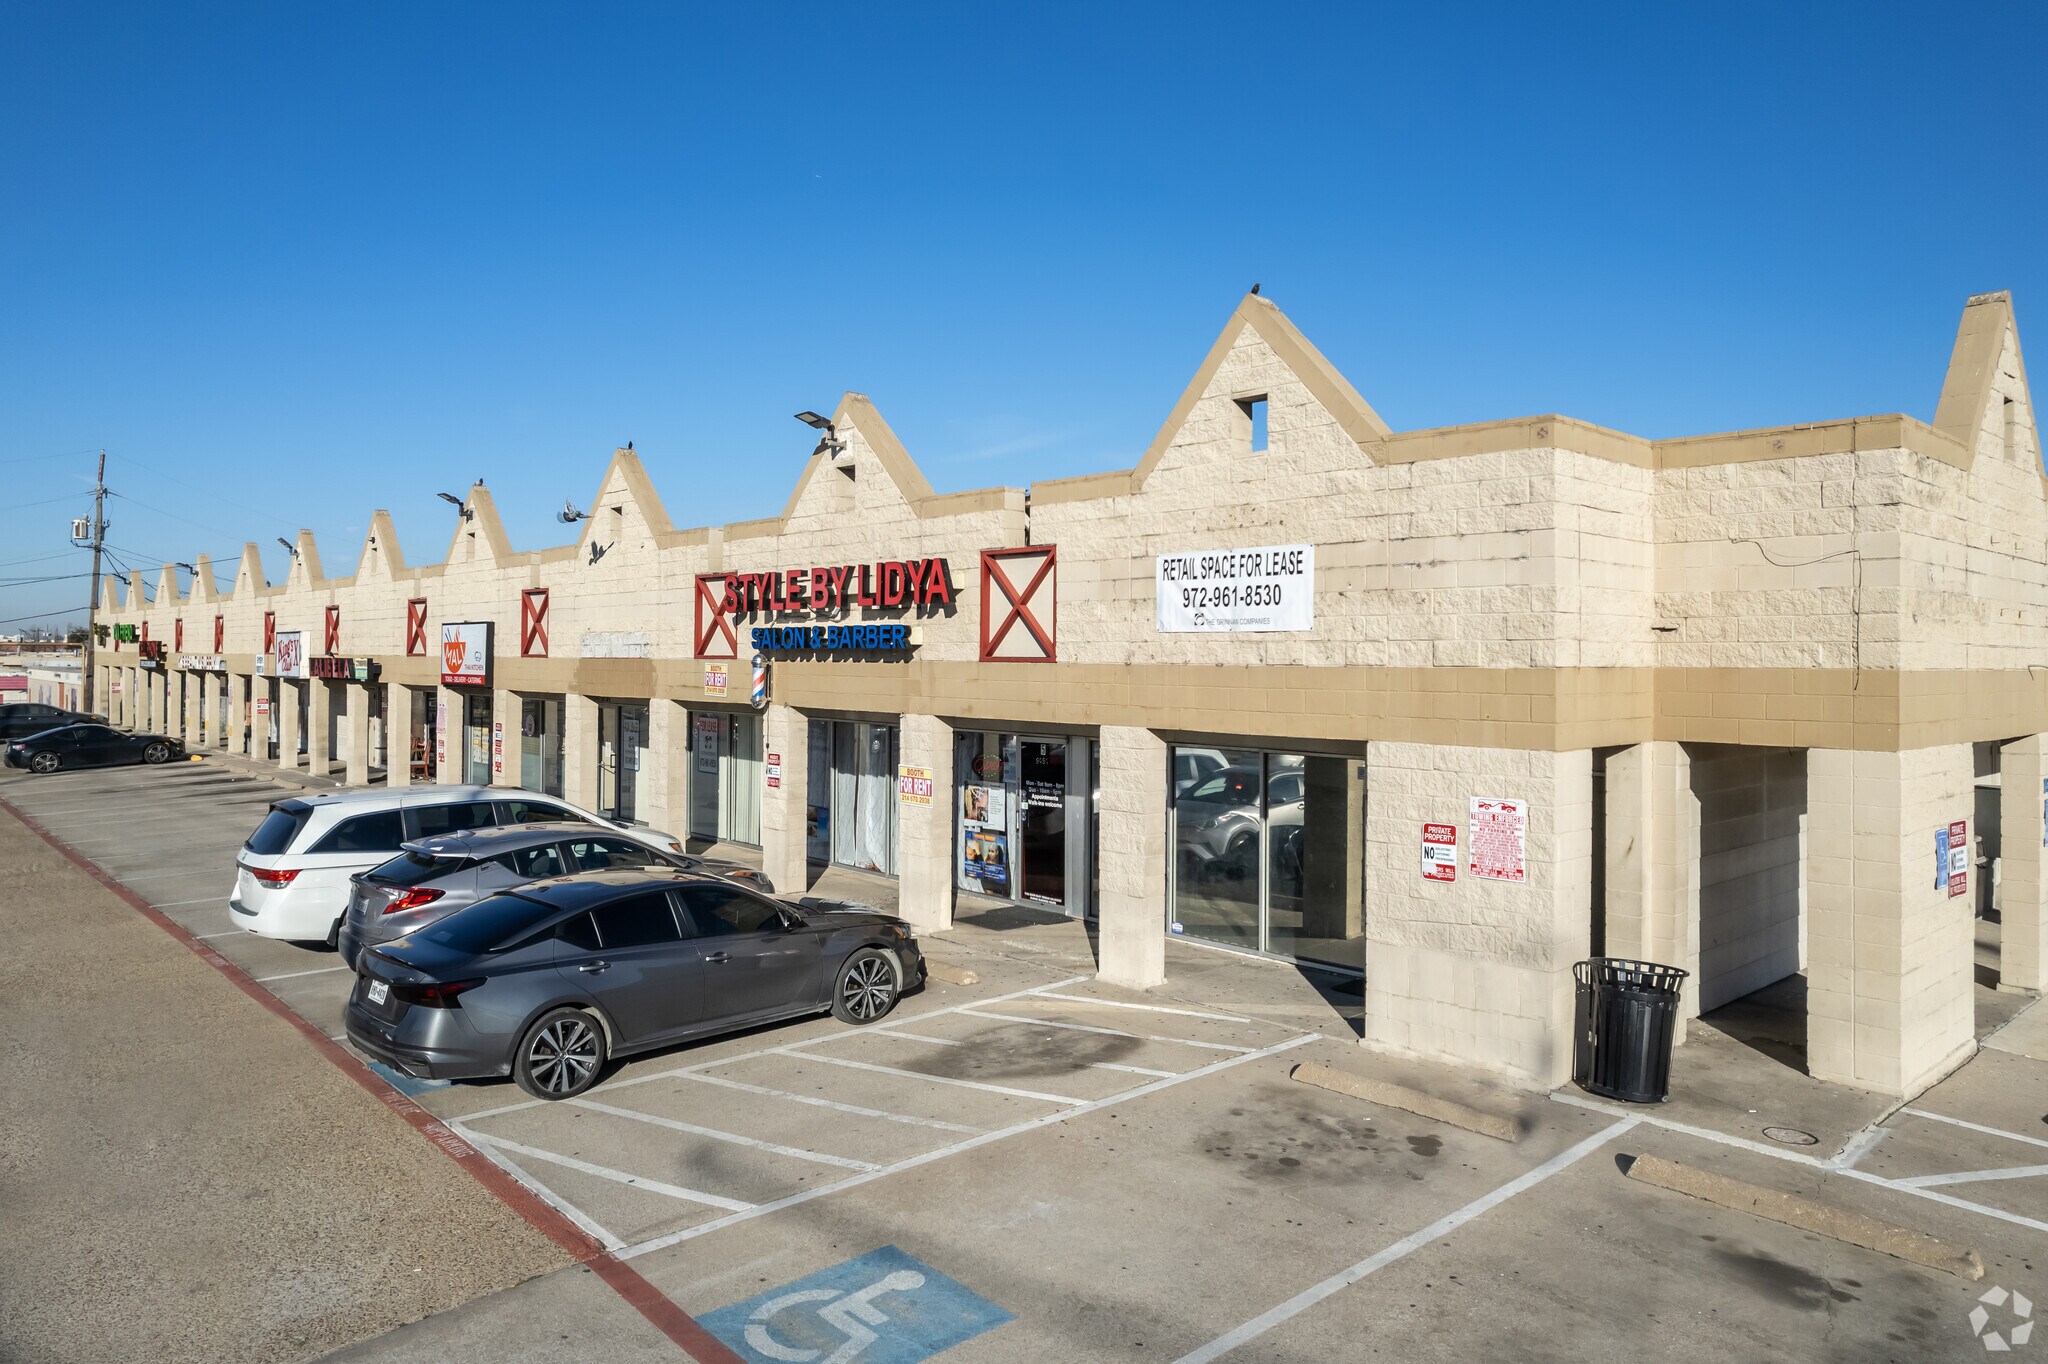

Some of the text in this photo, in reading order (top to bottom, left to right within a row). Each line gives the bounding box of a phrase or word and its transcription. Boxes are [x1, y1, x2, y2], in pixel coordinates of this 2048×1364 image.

[1162, 550, 1304, 582] RETAIL SPACE FOR LEASE
[724, 558, 949, 613] STYLE BY LIDYA
[1182, 584, 1282, 608] 972-961-8530
[751, 624, 906, 650] SALON & BARBER
[906, 768, 924, 777] BOOTH
[901, 776, 931, 796] FOR RENT
[1424, 833, 1455, 842] PROPERTY
[1427, 826, 1452, 835] PRIVATE
[1424, 846, 1435, 859] NO
